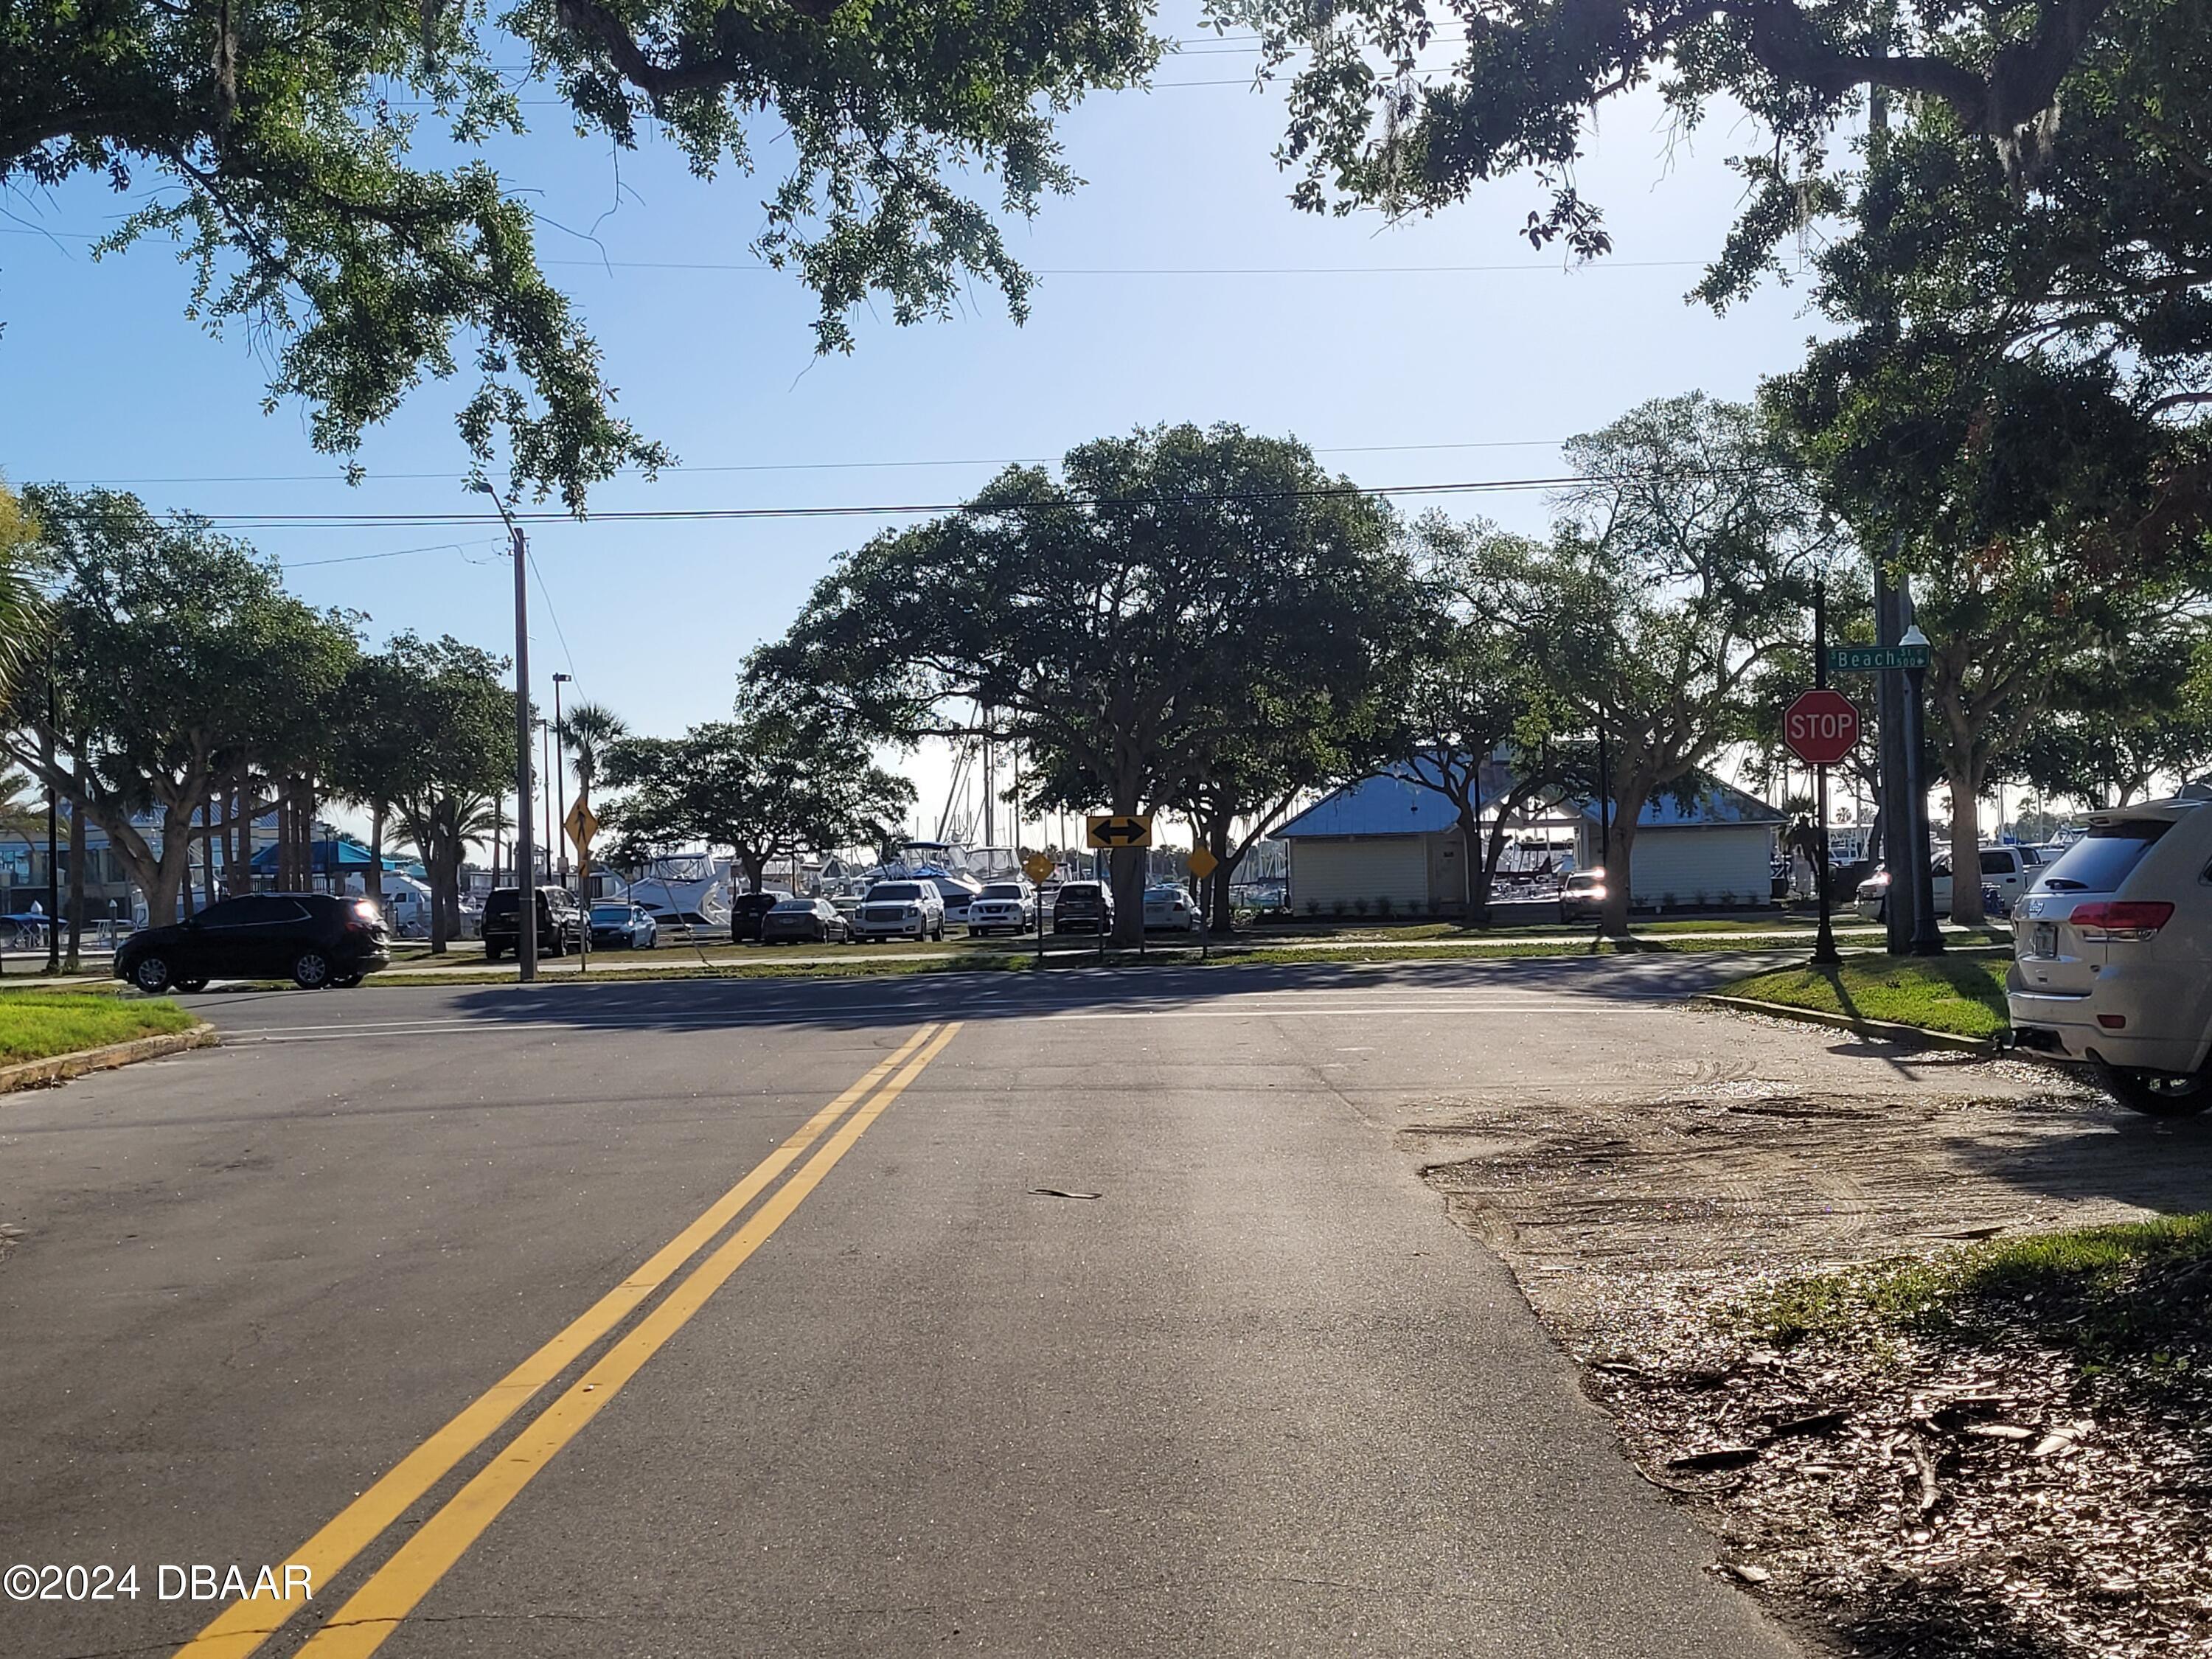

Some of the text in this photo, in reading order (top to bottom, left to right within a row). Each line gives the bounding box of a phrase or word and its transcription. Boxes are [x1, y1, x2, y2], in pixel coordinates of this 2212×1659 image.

[1831, 651, 1837, 660] S
[1838, 650, 1894, 667] Beach
[1897, 658, 1916, 667] 500
[1791, 713, 1852, 740] STOP
